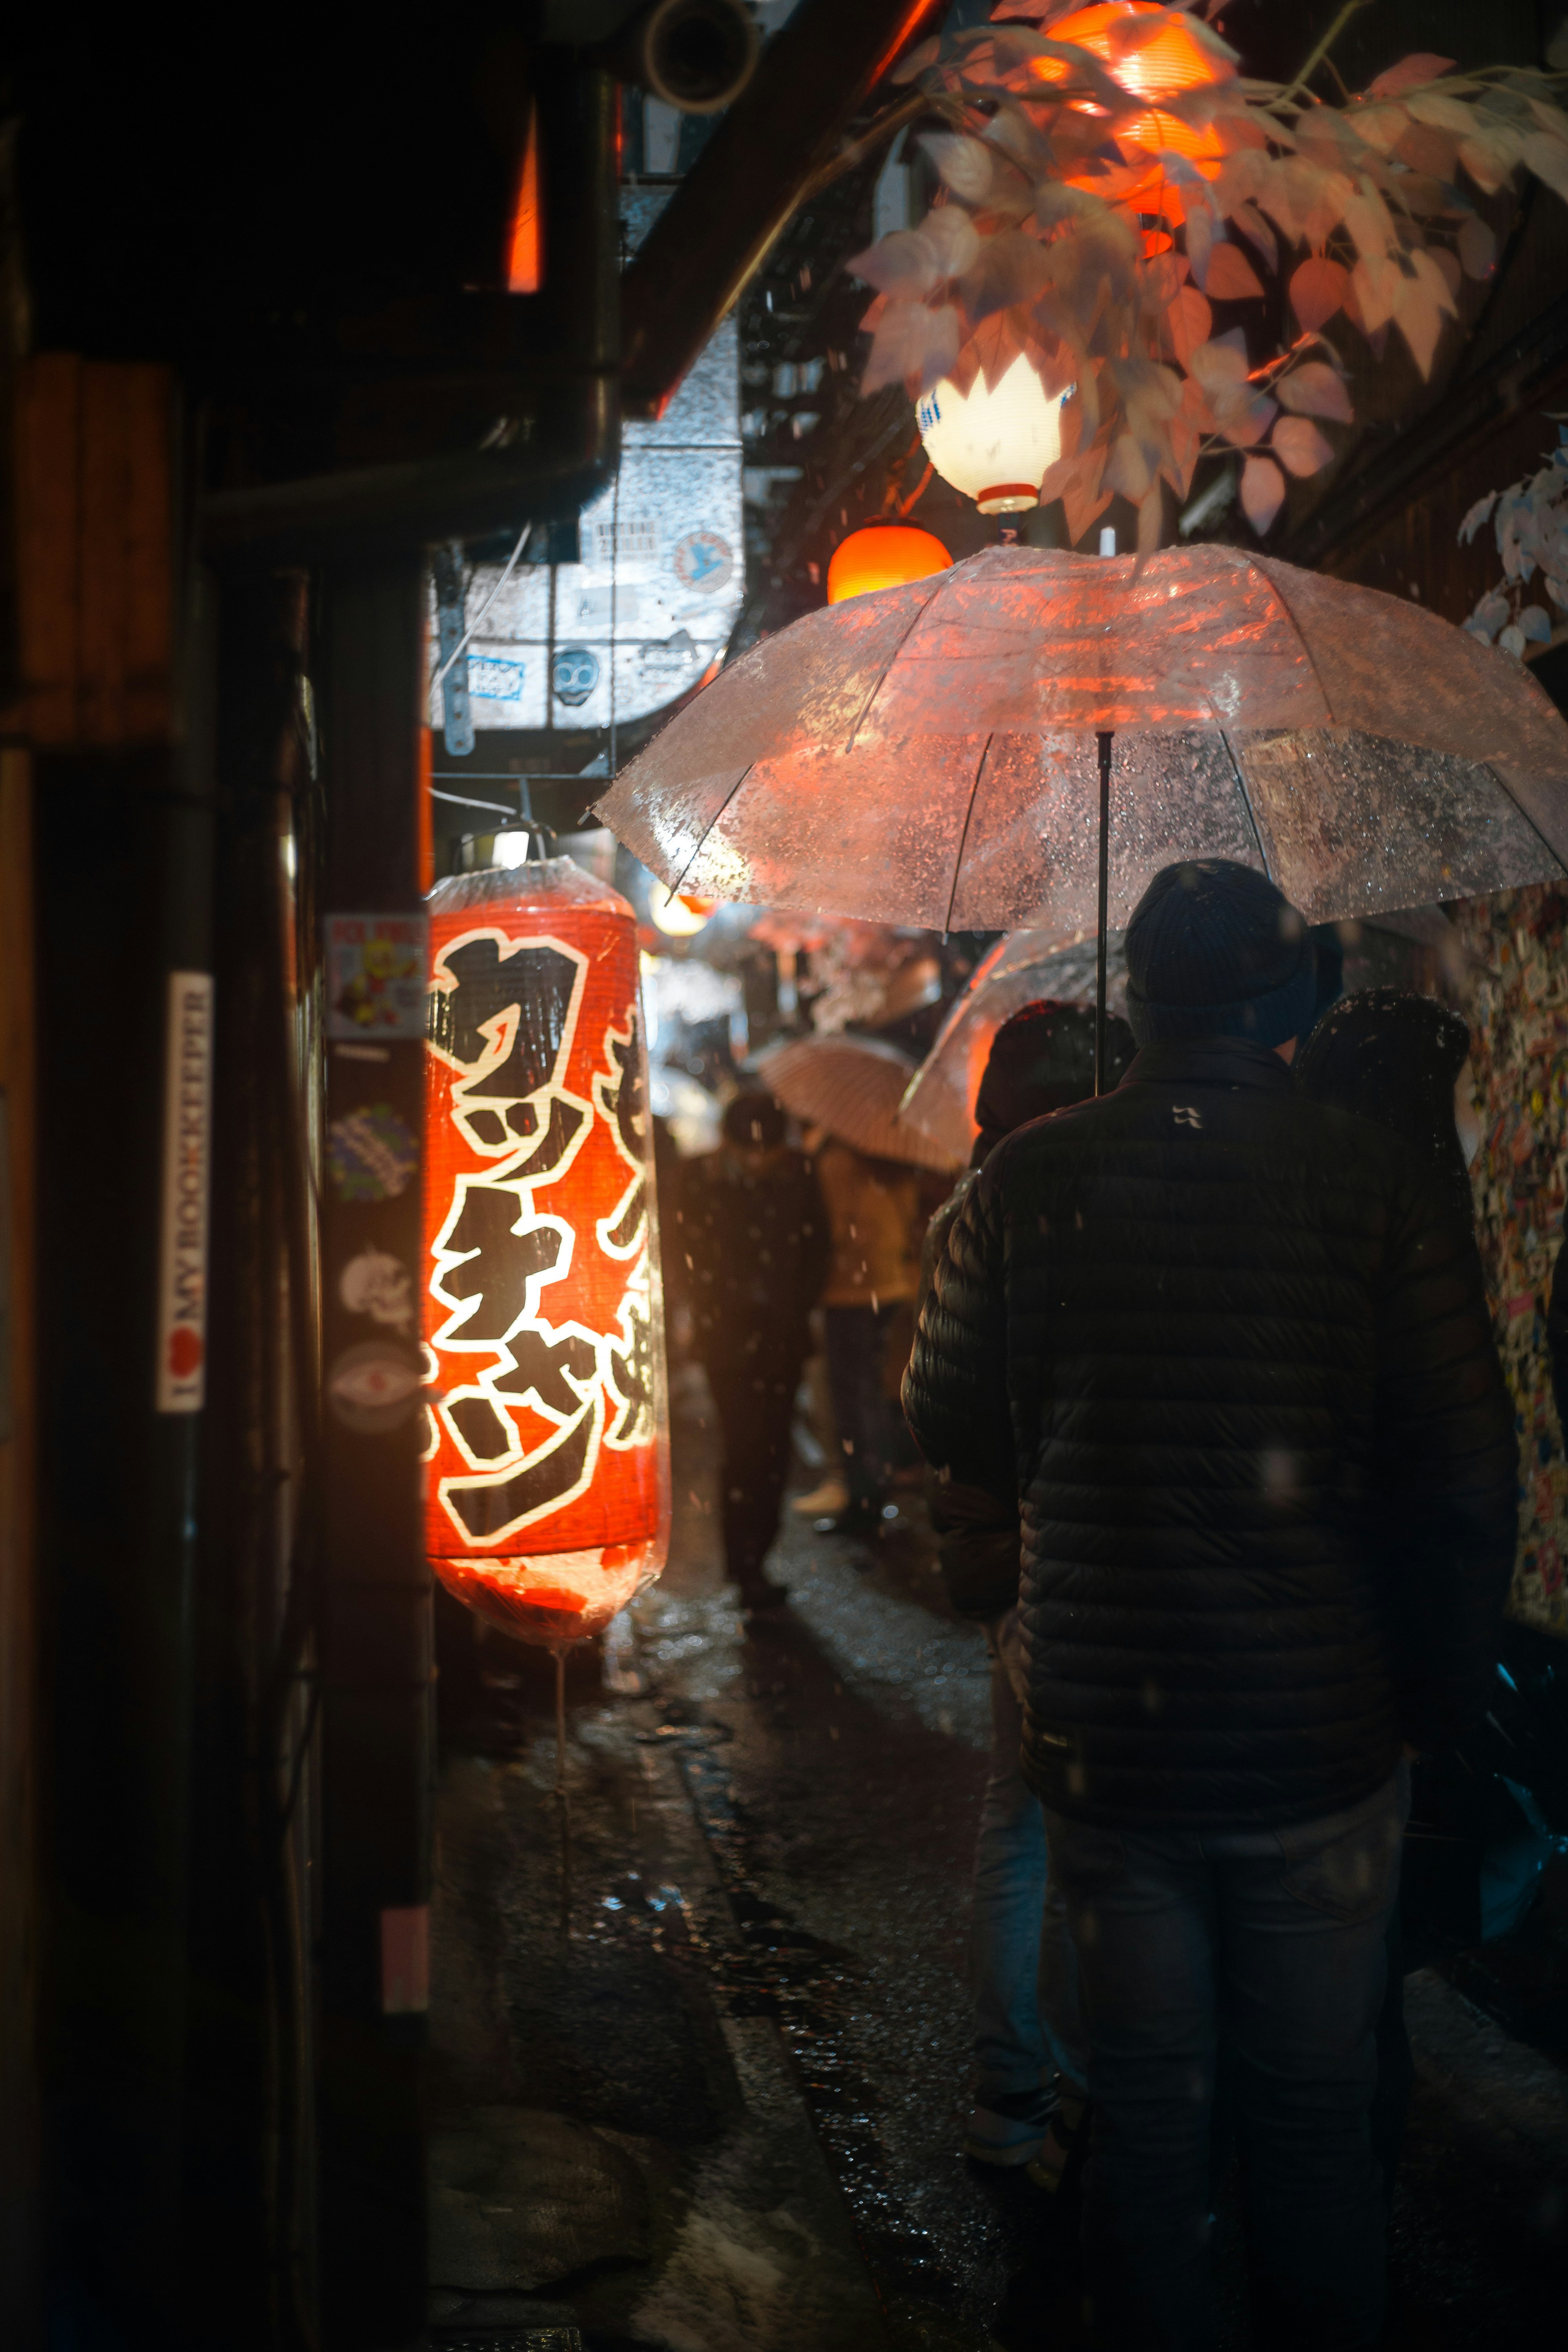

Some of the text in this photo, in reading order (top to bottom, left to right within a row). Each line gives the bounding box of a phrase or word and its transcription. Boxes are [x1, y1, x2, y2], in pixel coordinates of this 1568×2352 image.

[173, 991, 204, 1397] I MY BOOKKEEPER
